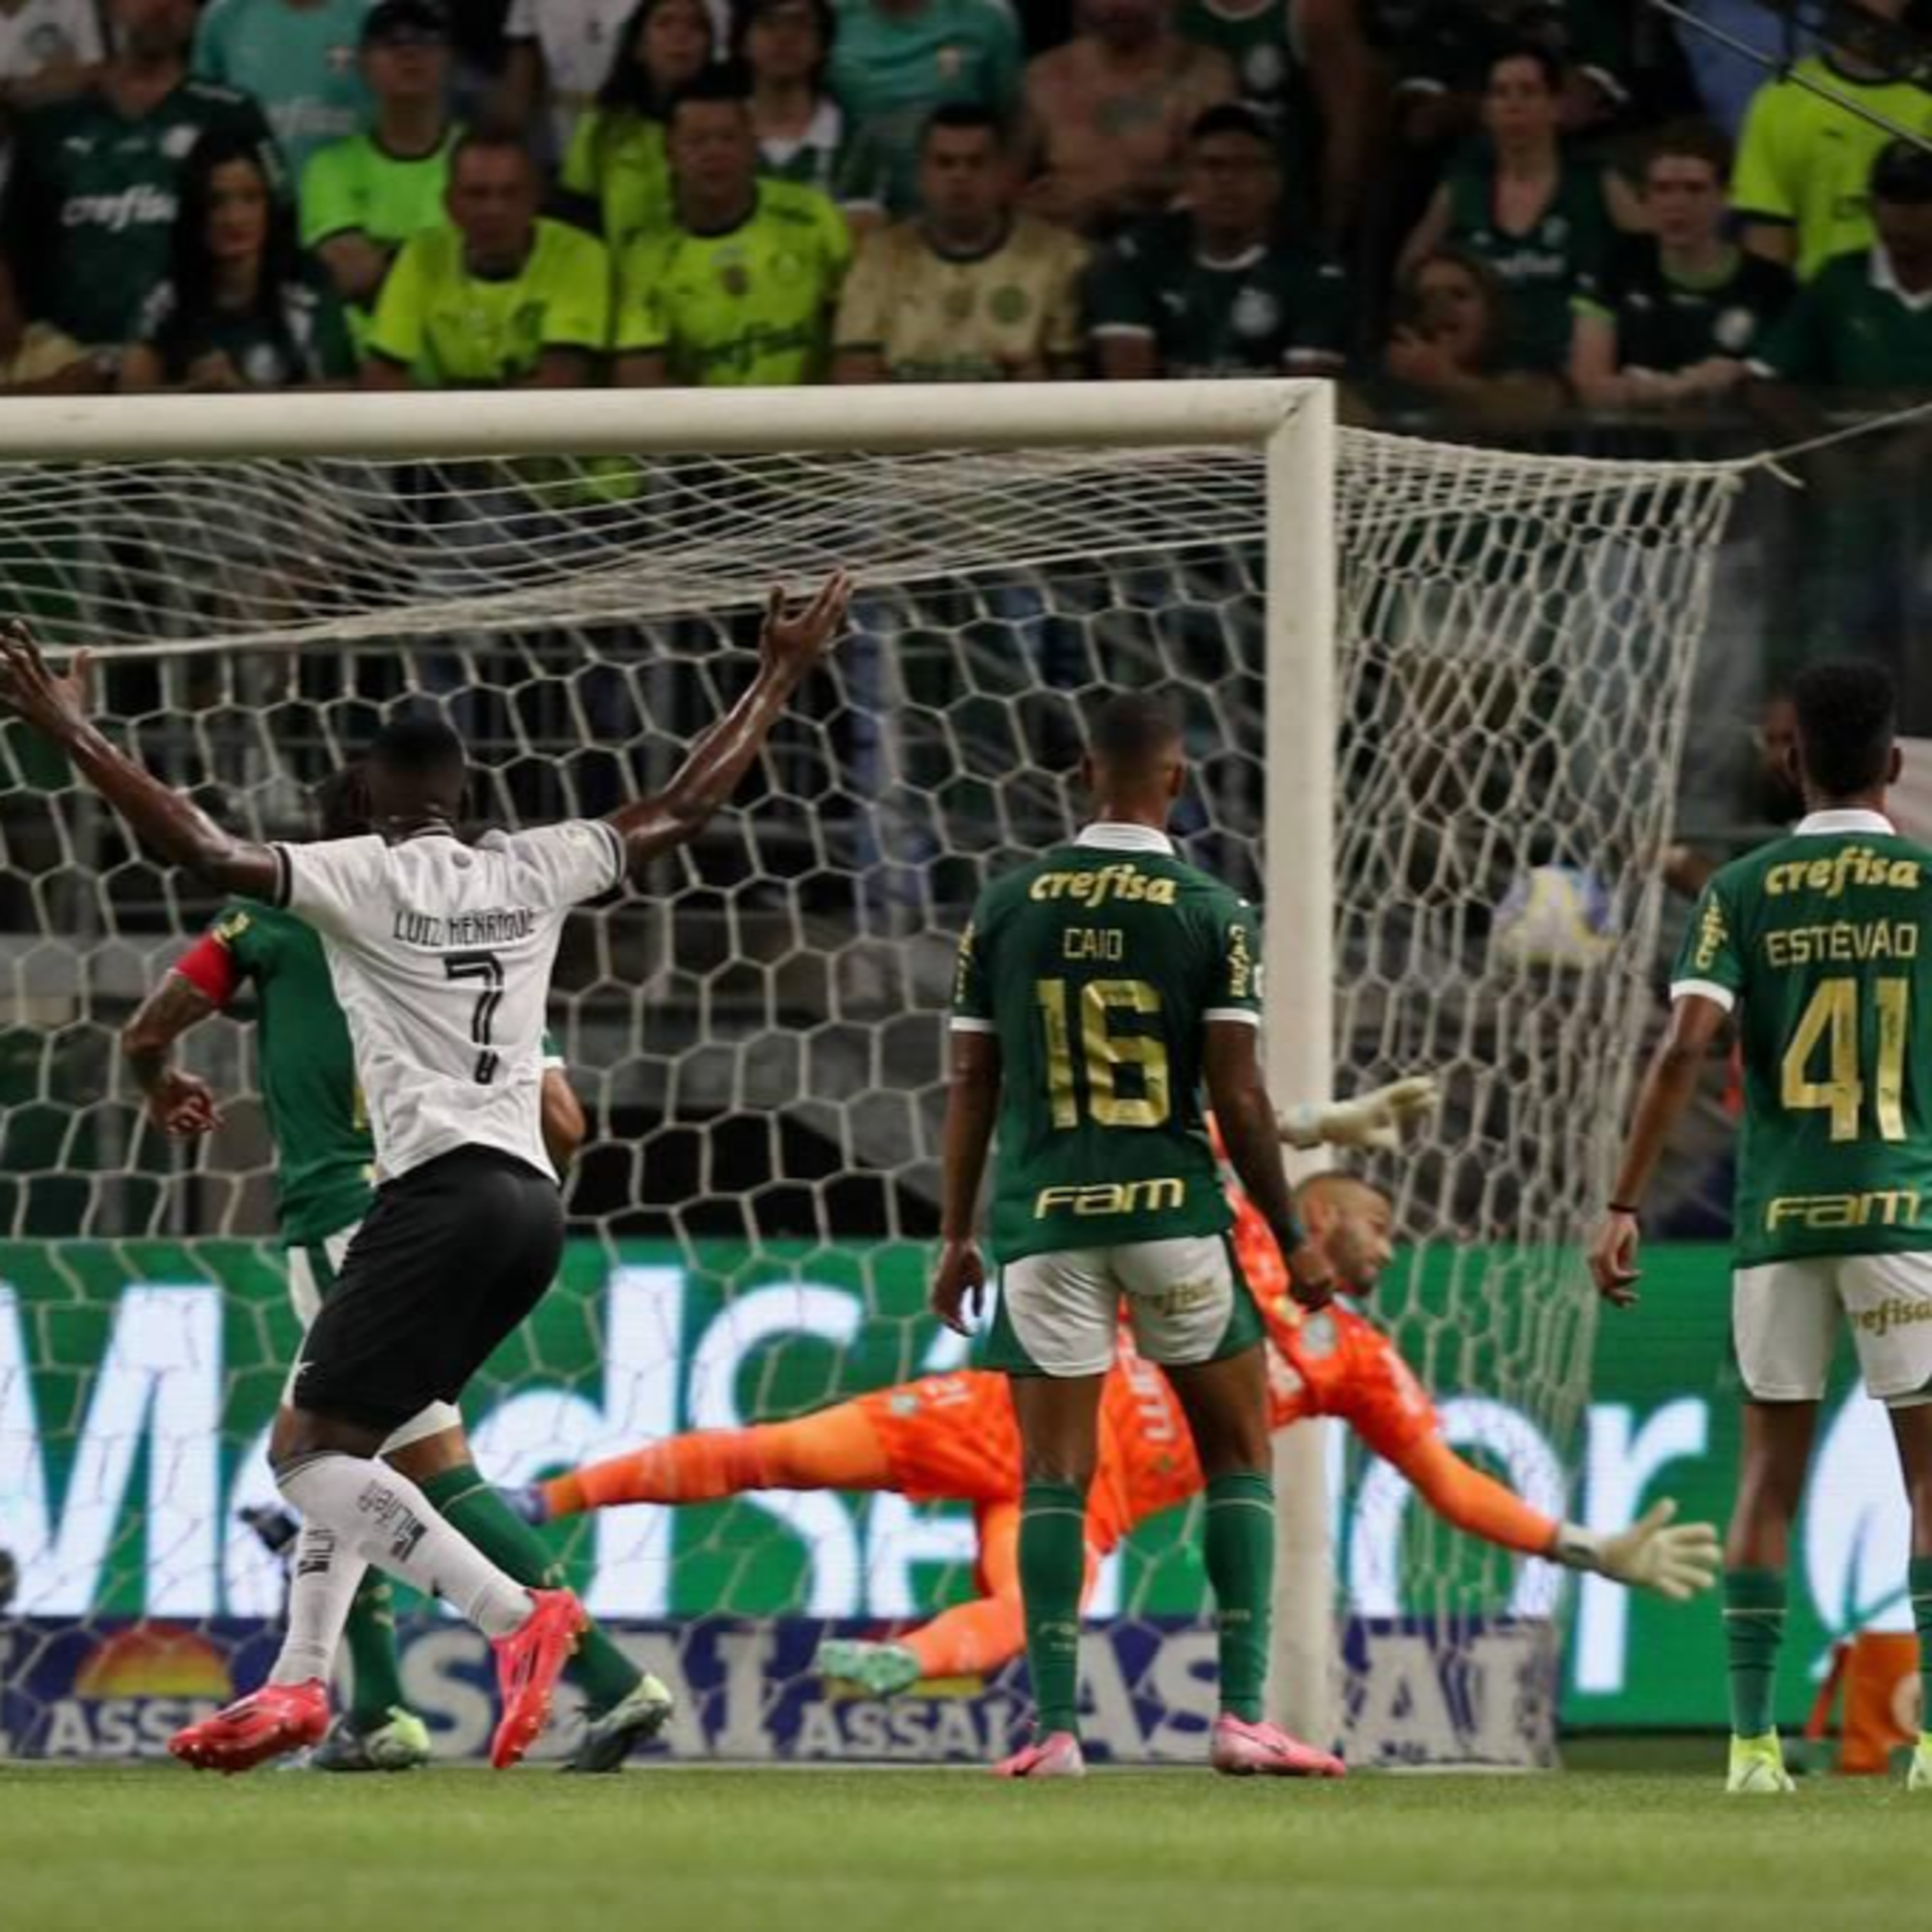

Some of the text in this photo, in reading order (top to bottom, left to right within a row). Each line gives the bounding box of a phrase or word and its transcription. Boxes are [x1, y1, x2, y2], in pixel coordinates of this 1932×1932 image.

[1030, 864, 1176, 907] crefisa
[1765, 848, 1920, 896] crefisa
[392, 909, 444, 947] LUIZ
[1063, 928, 1123, 960] CAIO
[1765, 917, 1918, 966] ESTÊVÃO
[442, 949, 505, 1085] 7
[1037, 978, 1170, 1128] 16
[1781, 977, 1909, 1141] 41
